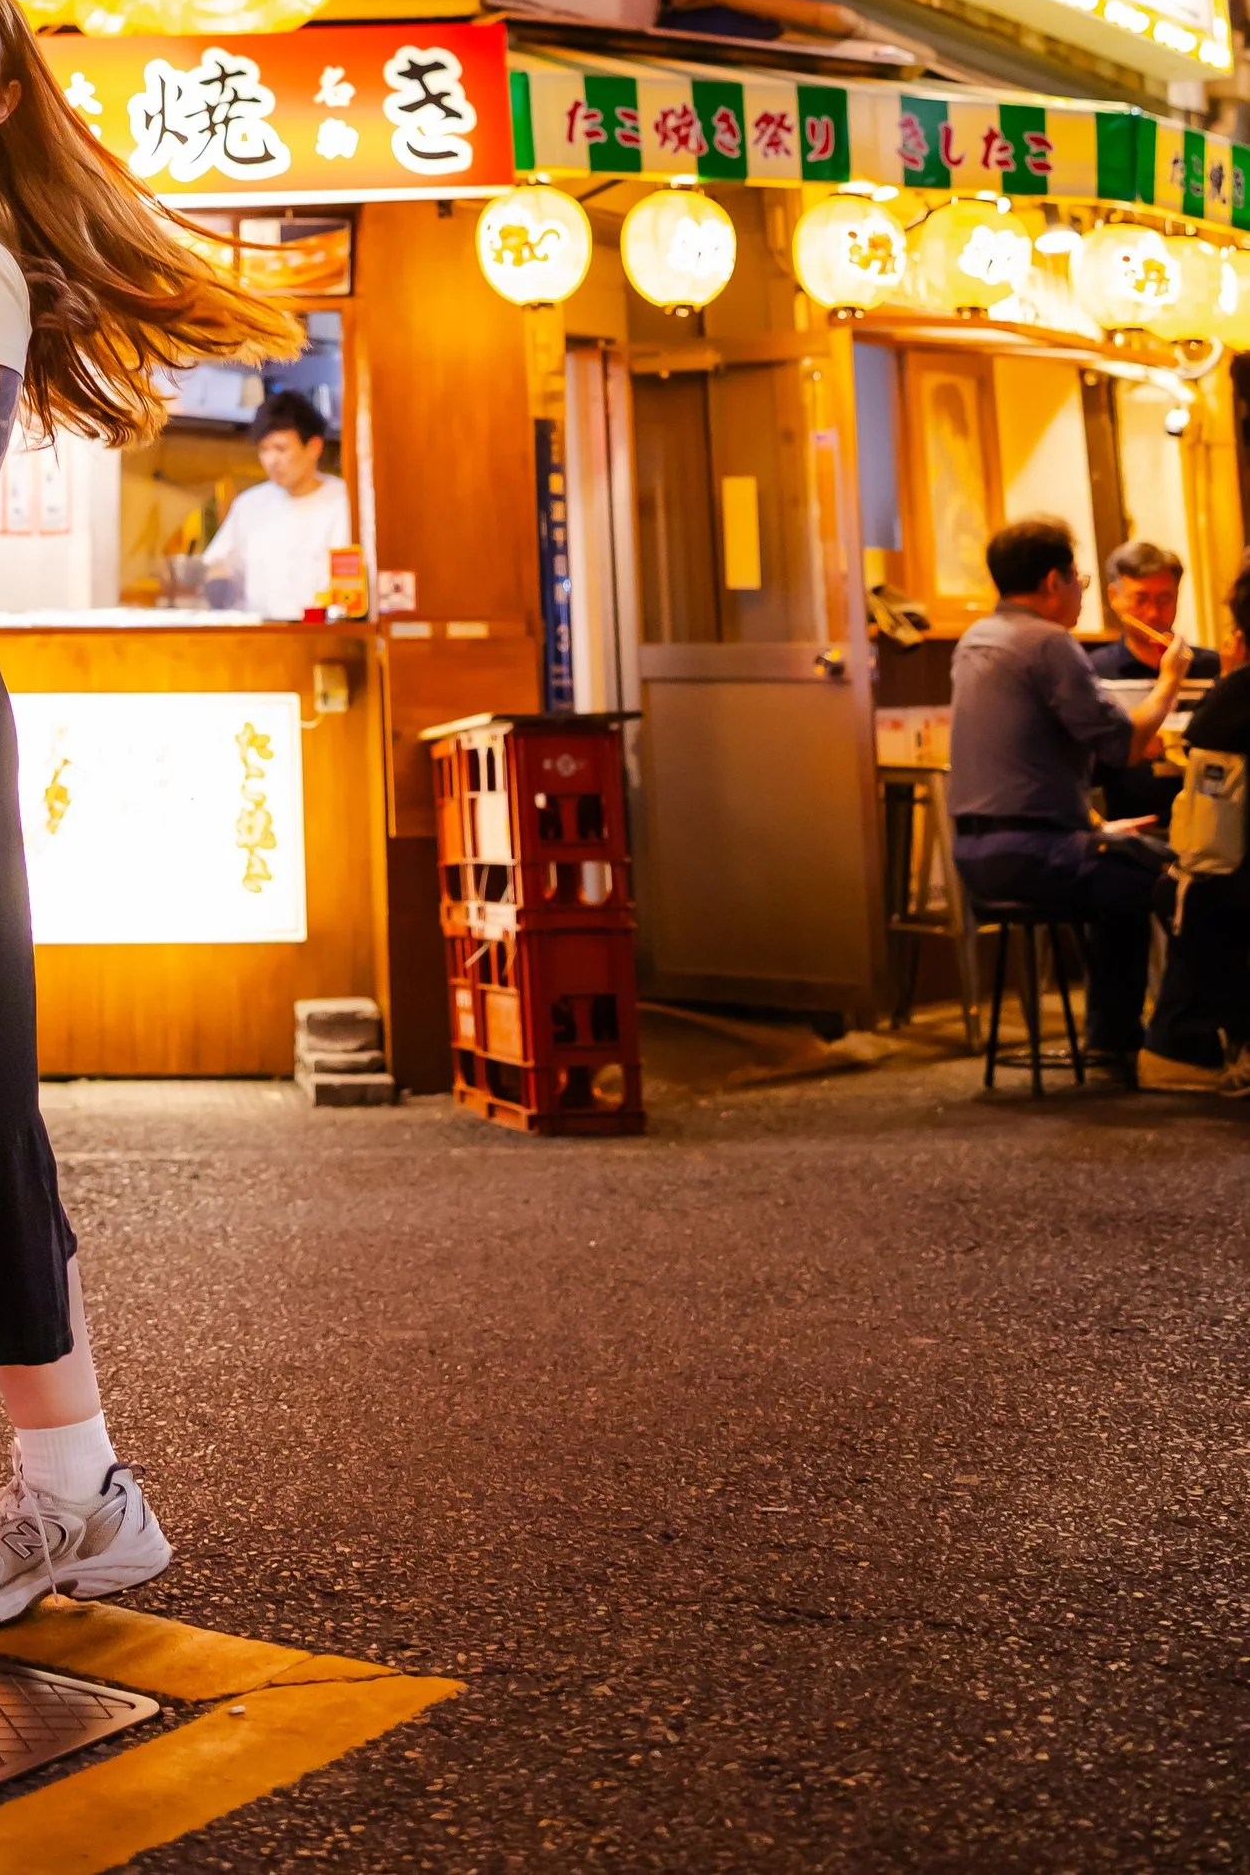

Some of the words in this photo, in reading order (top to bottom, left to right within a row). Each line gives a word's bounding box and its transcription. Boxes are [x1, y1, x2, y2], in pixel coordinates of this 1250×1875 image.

[566, 96, 835, 163] たこ焼き祭り
[1, 1521, 49, 1560] N
